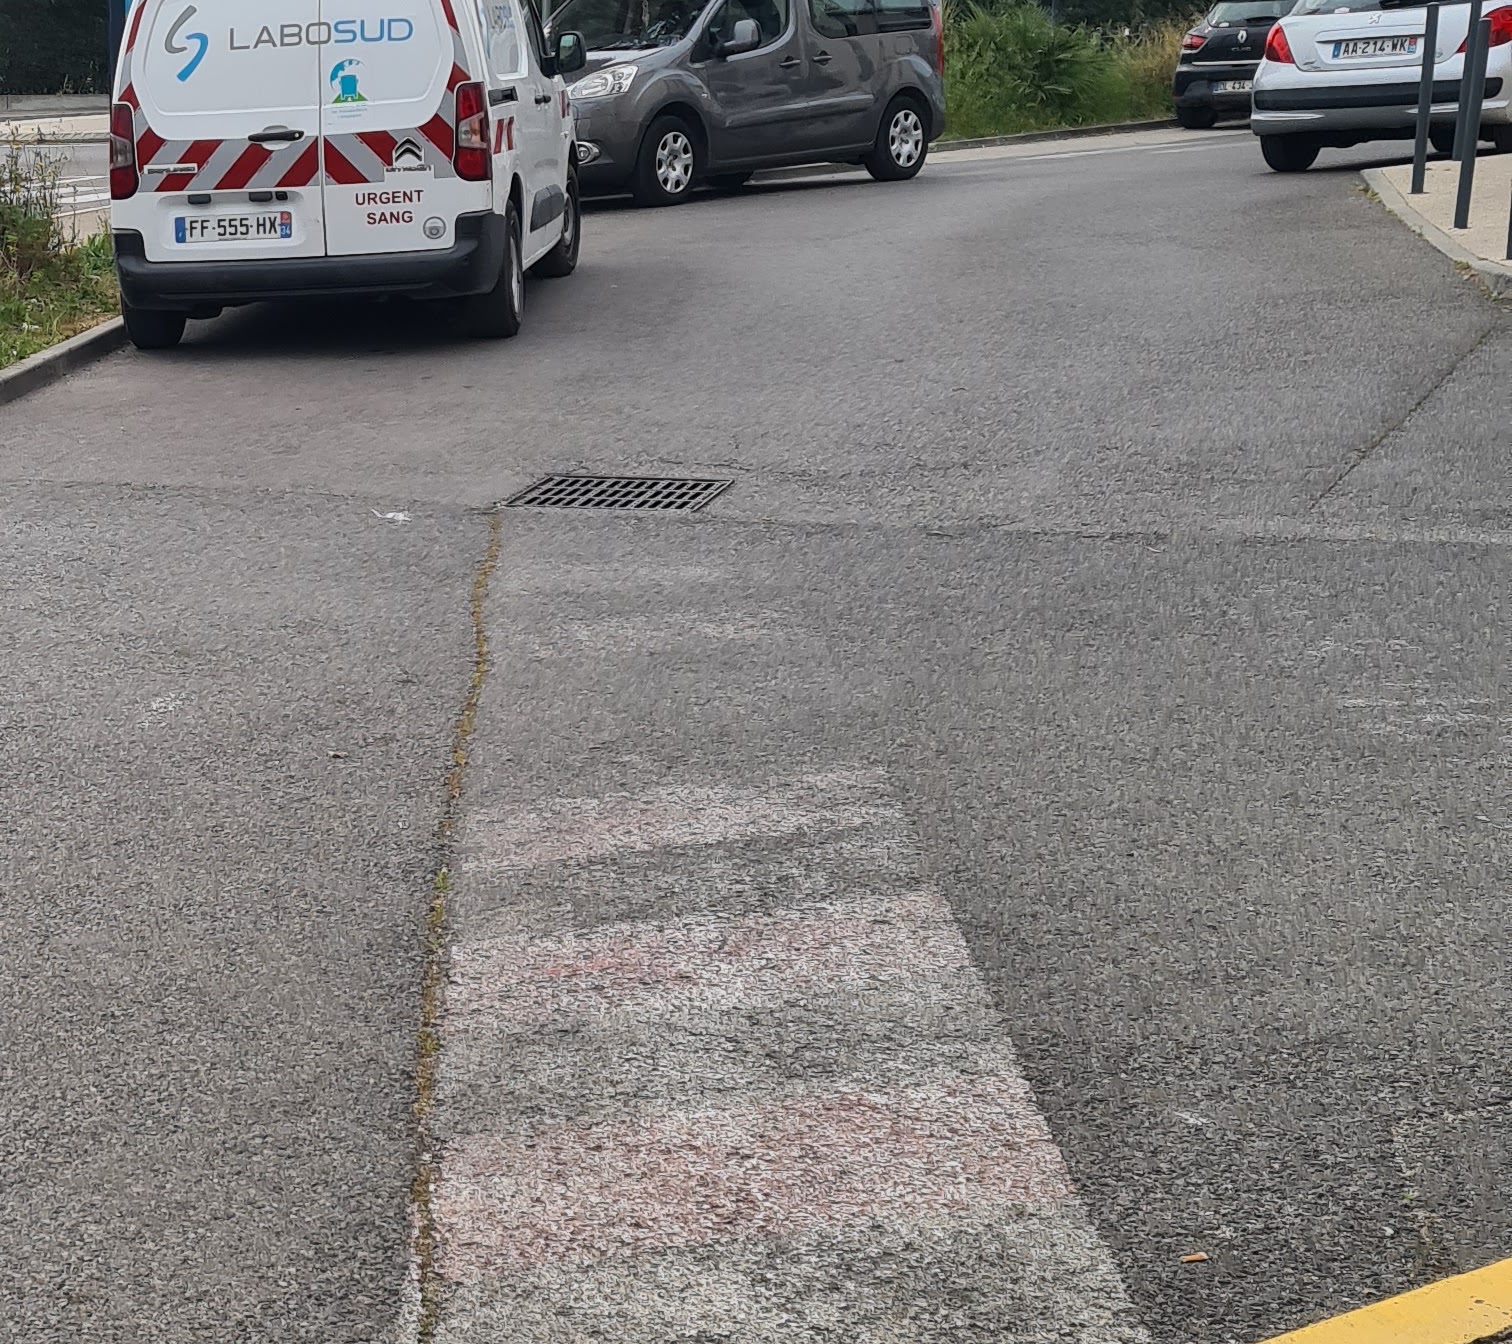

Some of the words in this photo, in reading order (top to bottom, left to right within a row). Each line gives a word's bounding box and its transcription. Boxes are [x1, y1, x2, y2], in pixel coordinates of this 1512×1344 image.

[229, 18, 414, 51] LABOSUD
[355, 189, 424, 206] URGENT
[189, 216, 278, 238] FF-555-HX
[366, 210, 414, 225] SANG
